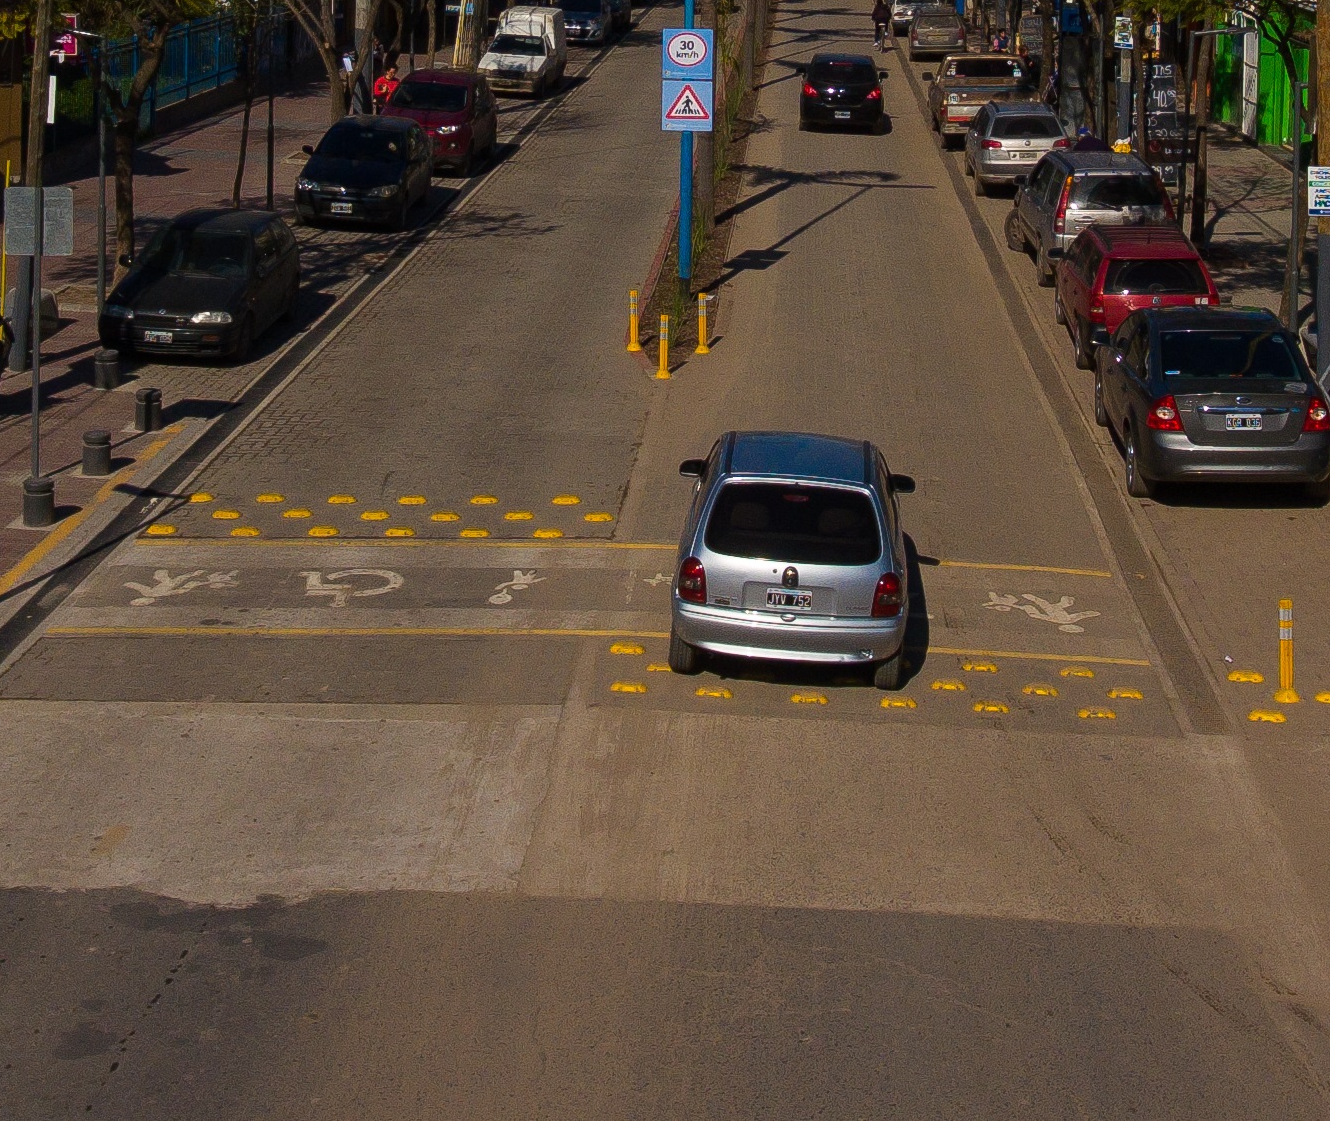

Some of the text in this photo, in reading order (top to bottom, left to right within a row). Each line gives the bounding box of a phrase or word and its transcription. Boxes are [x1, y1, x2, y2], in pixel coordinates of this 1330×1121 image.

[679, 41, 694, 50] 30
[676, 50, 699, 59] km/h
[768, 593, 811, 607] JYV 752
